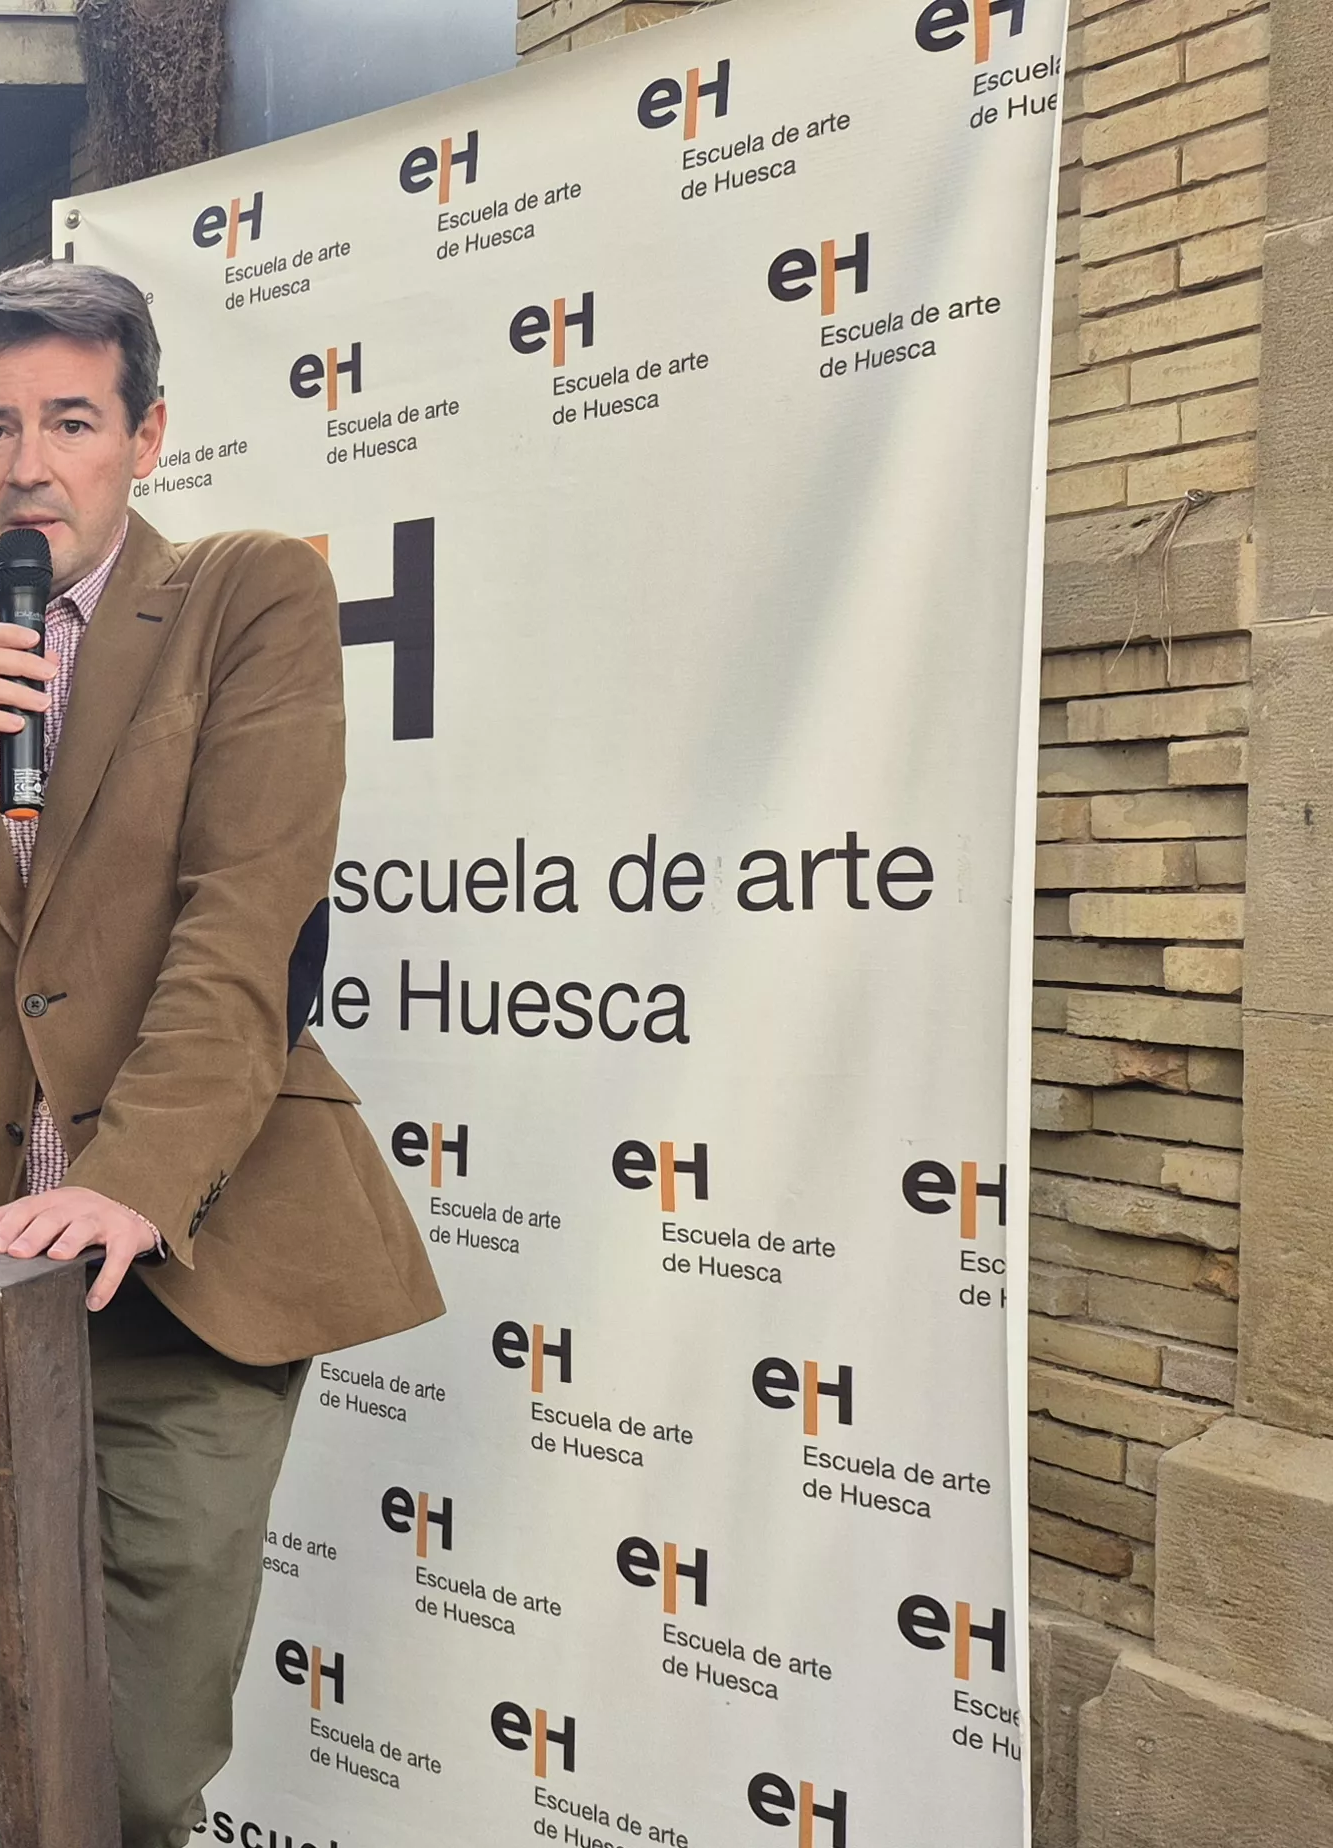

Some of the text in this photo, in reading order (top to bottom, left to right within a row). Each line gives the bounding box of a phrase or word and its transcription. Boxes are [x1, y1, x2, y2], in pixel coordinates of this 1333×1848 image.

[637, 59, 730, 140] eH
[969, 105, 999, 130] de
[682, 112, 851, 171] Escuela de arte
[399, 130, 478, 204] eH
[680, 157, 797, 201] de Huesca
[193, 191, 263, 258] eH
[437, 182, 582, 233] Escuela de arte
[225, 241, 351, 285] Escuela de arte
[436, 223, 536, 261] de Huesca
[225, 278, 311, 311] de Huesca
[768, 232, 869, 316] eH
[509, 291, 594, 367] eH
[820, 295, 1001, 348] Escuela de arte
[290, 342, 362, 412] eH
[553, 352, 709, 397] Escuela de arte
[819, 339, 937, 379] de Huesca
[327, 398, 460, 438] Escuela de arte
[552, 393, 660, 426] de Huesca
[158, 439, 248, 469] uela de arte
[326, 436, 418, 465] de Huesca
[132, 473, 213, 498] de Huesca
[332, 830, 935, 914] scuela de arte
[399, 958, 691, 1045] Huesca
[391, 1121, 468, 1187] eH
[612, 1140, 708, 1212] eH
[430, 1196, 562, 1230] Escuela de arte
[429, 1224, 520, 1254] de Huesca
[661, 1221, 836, 1259] Escuela de arte
[662, 1252, 783, 1285] de Huesca
[958, 1283, 992, 1308] de
[492, 1321, 572, 1393] eH
[320, 1361, 446, 1402] Escuela de arte
[752, 1357, 853, 1436] eH
[319, 1389, 407, 1423] de Huesca
[531, 1401, 694, 1446] Escuela de arte
[530, 1431, 644, 1468] de Huesca
[803, 1444, 992, 1496] Escuela de arte
[802, 1477, 932, 1519] de Huesca
[381, 1486, 452, 1558] eH
[263, 1556, 299, 1578] esca
[282, 1531, 303, 1552] de
[306, 1540, 338, 1561] arte
[415, 1565, 562, 1617] Escuela de arte
[617, 1536, 708, 1614] eH
[414, 1595, 516, 1635] de Huesca
[897, 1594, 1006, 1680] eH
[663, 1622, 833, 1681] Escuela de arte
[275, 1639, 344, 1710] eH
[661, 1654, 779, 1700] de Huesca
[310, 1717, 442, 1775] Escuela de arte
[491, 1701, 575, 1778] eH
[952, 1724, 984, 1750] de
[309, 1746, 400, 1789] de Huesca
[533, 1817, 558, 1840] de
[534, 1786, 689, 1848] Escuela de arte
